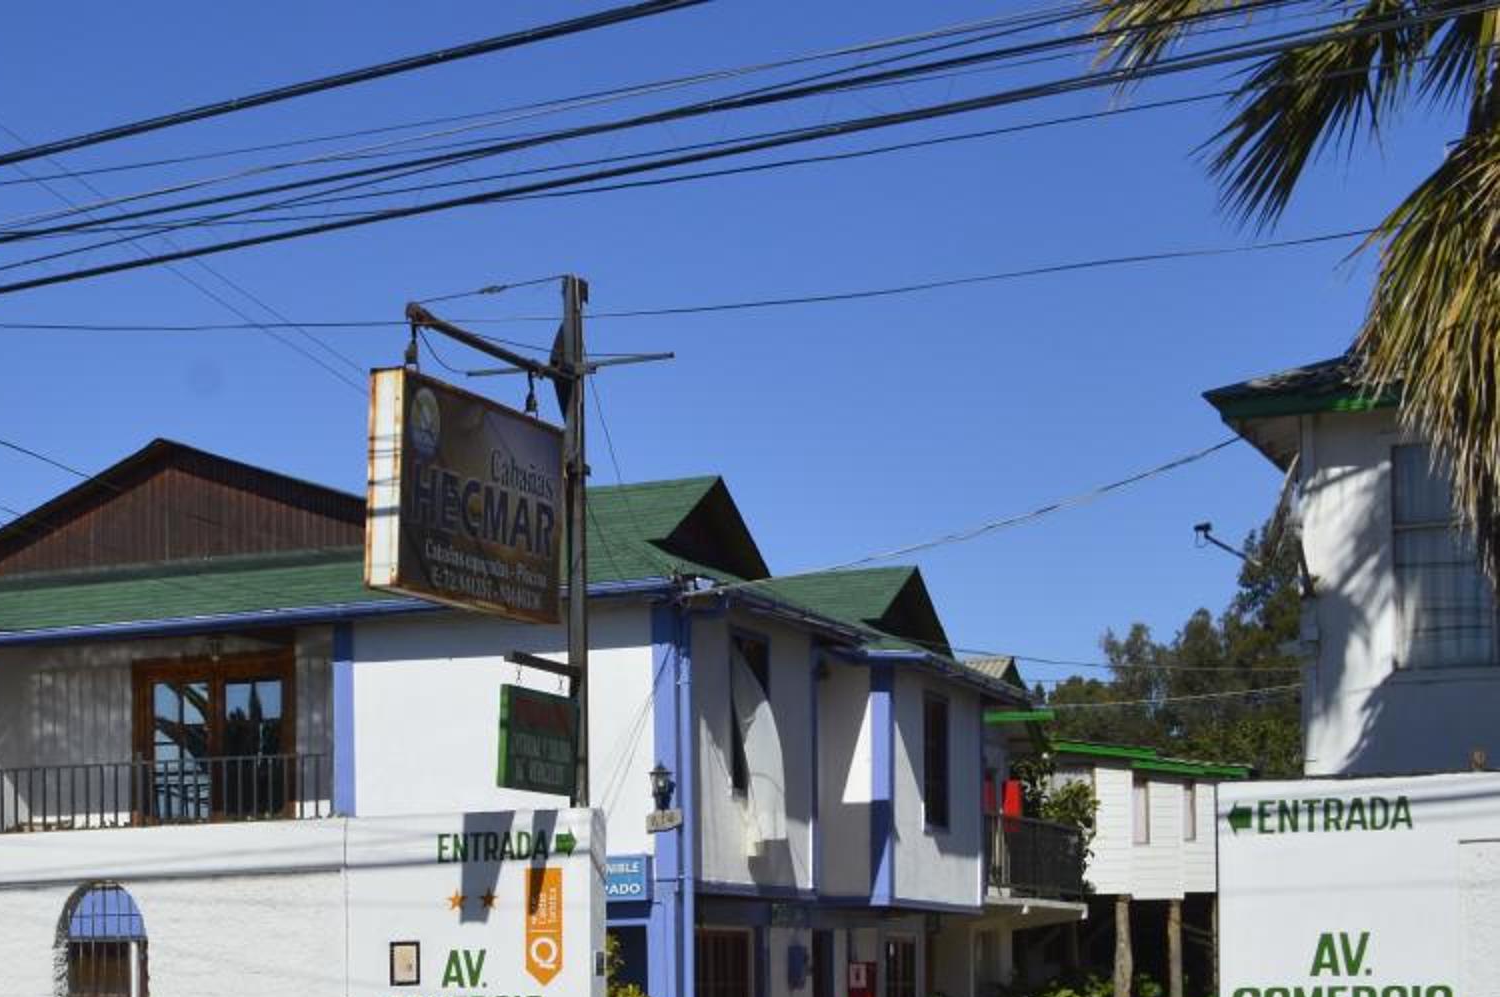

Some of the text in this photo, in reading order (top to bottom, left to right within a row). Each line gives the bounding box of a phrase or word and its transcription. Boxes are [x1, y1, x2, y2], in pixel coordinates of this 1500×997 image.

[491, 448, 554, 498] Cabañas
[411, 462, 556, 558] HECMAR
[1258, 796, 1414, 835] ENTRADA
[437, 831, 549, 864] ENTRADA
[441, 949, 488, 989] AV.
[1309, 932, 1373, 977] AV.
